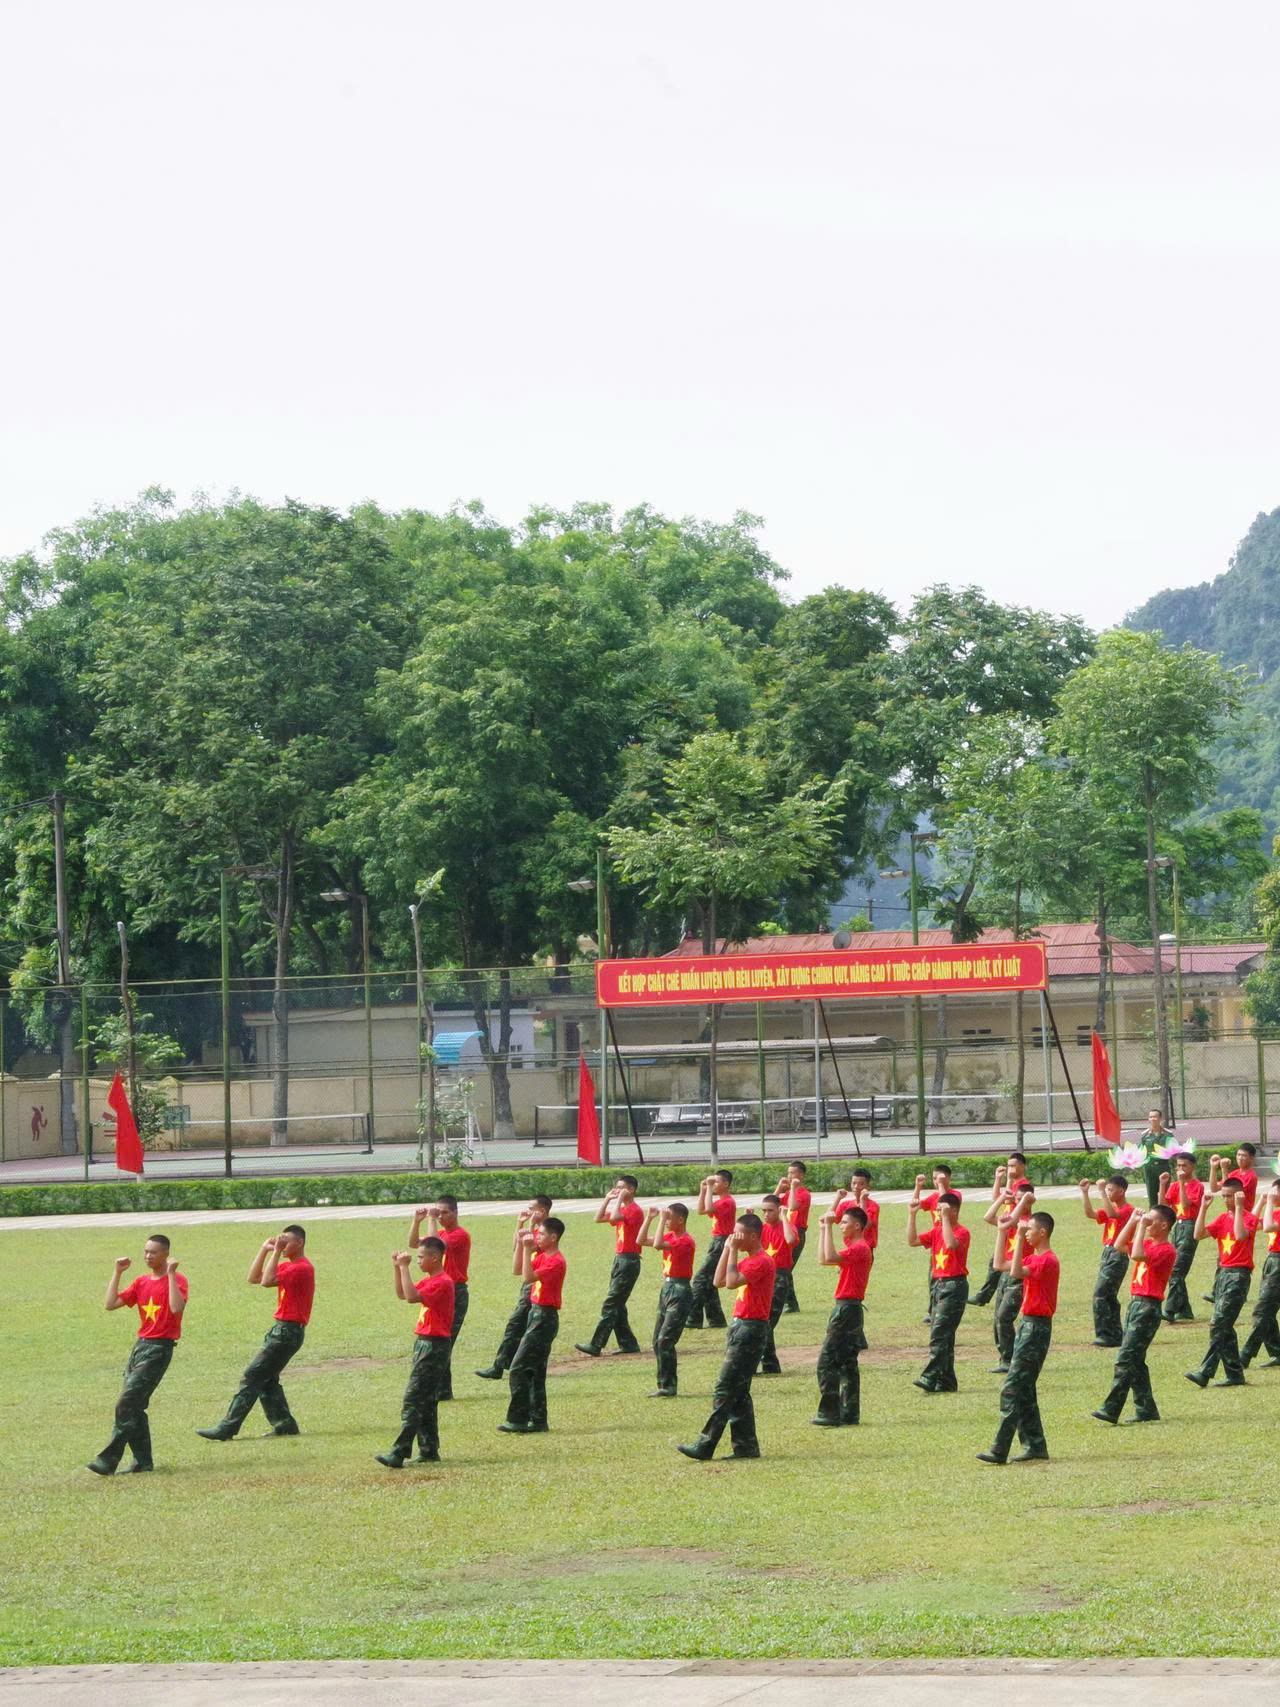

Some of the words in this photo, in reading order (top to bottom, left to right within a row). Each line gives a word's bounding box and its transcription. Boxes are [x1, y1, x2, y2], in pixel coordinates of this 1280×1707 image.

[619, 970, 631, 992] KẾT
[701, 968, 722, 992] LUYỆN
[776, 964, 789, 986] XÂY
[871, 964, 885, 982] CAO
[886, 960, 891, 982] Ý
[912, 956, 930, 980] CHẤP
[953, 956, 972, 978] PHÁP
[973, 956, 992, 982] LUẬT,
[1004, 955, 1021, 980] LUẬT
